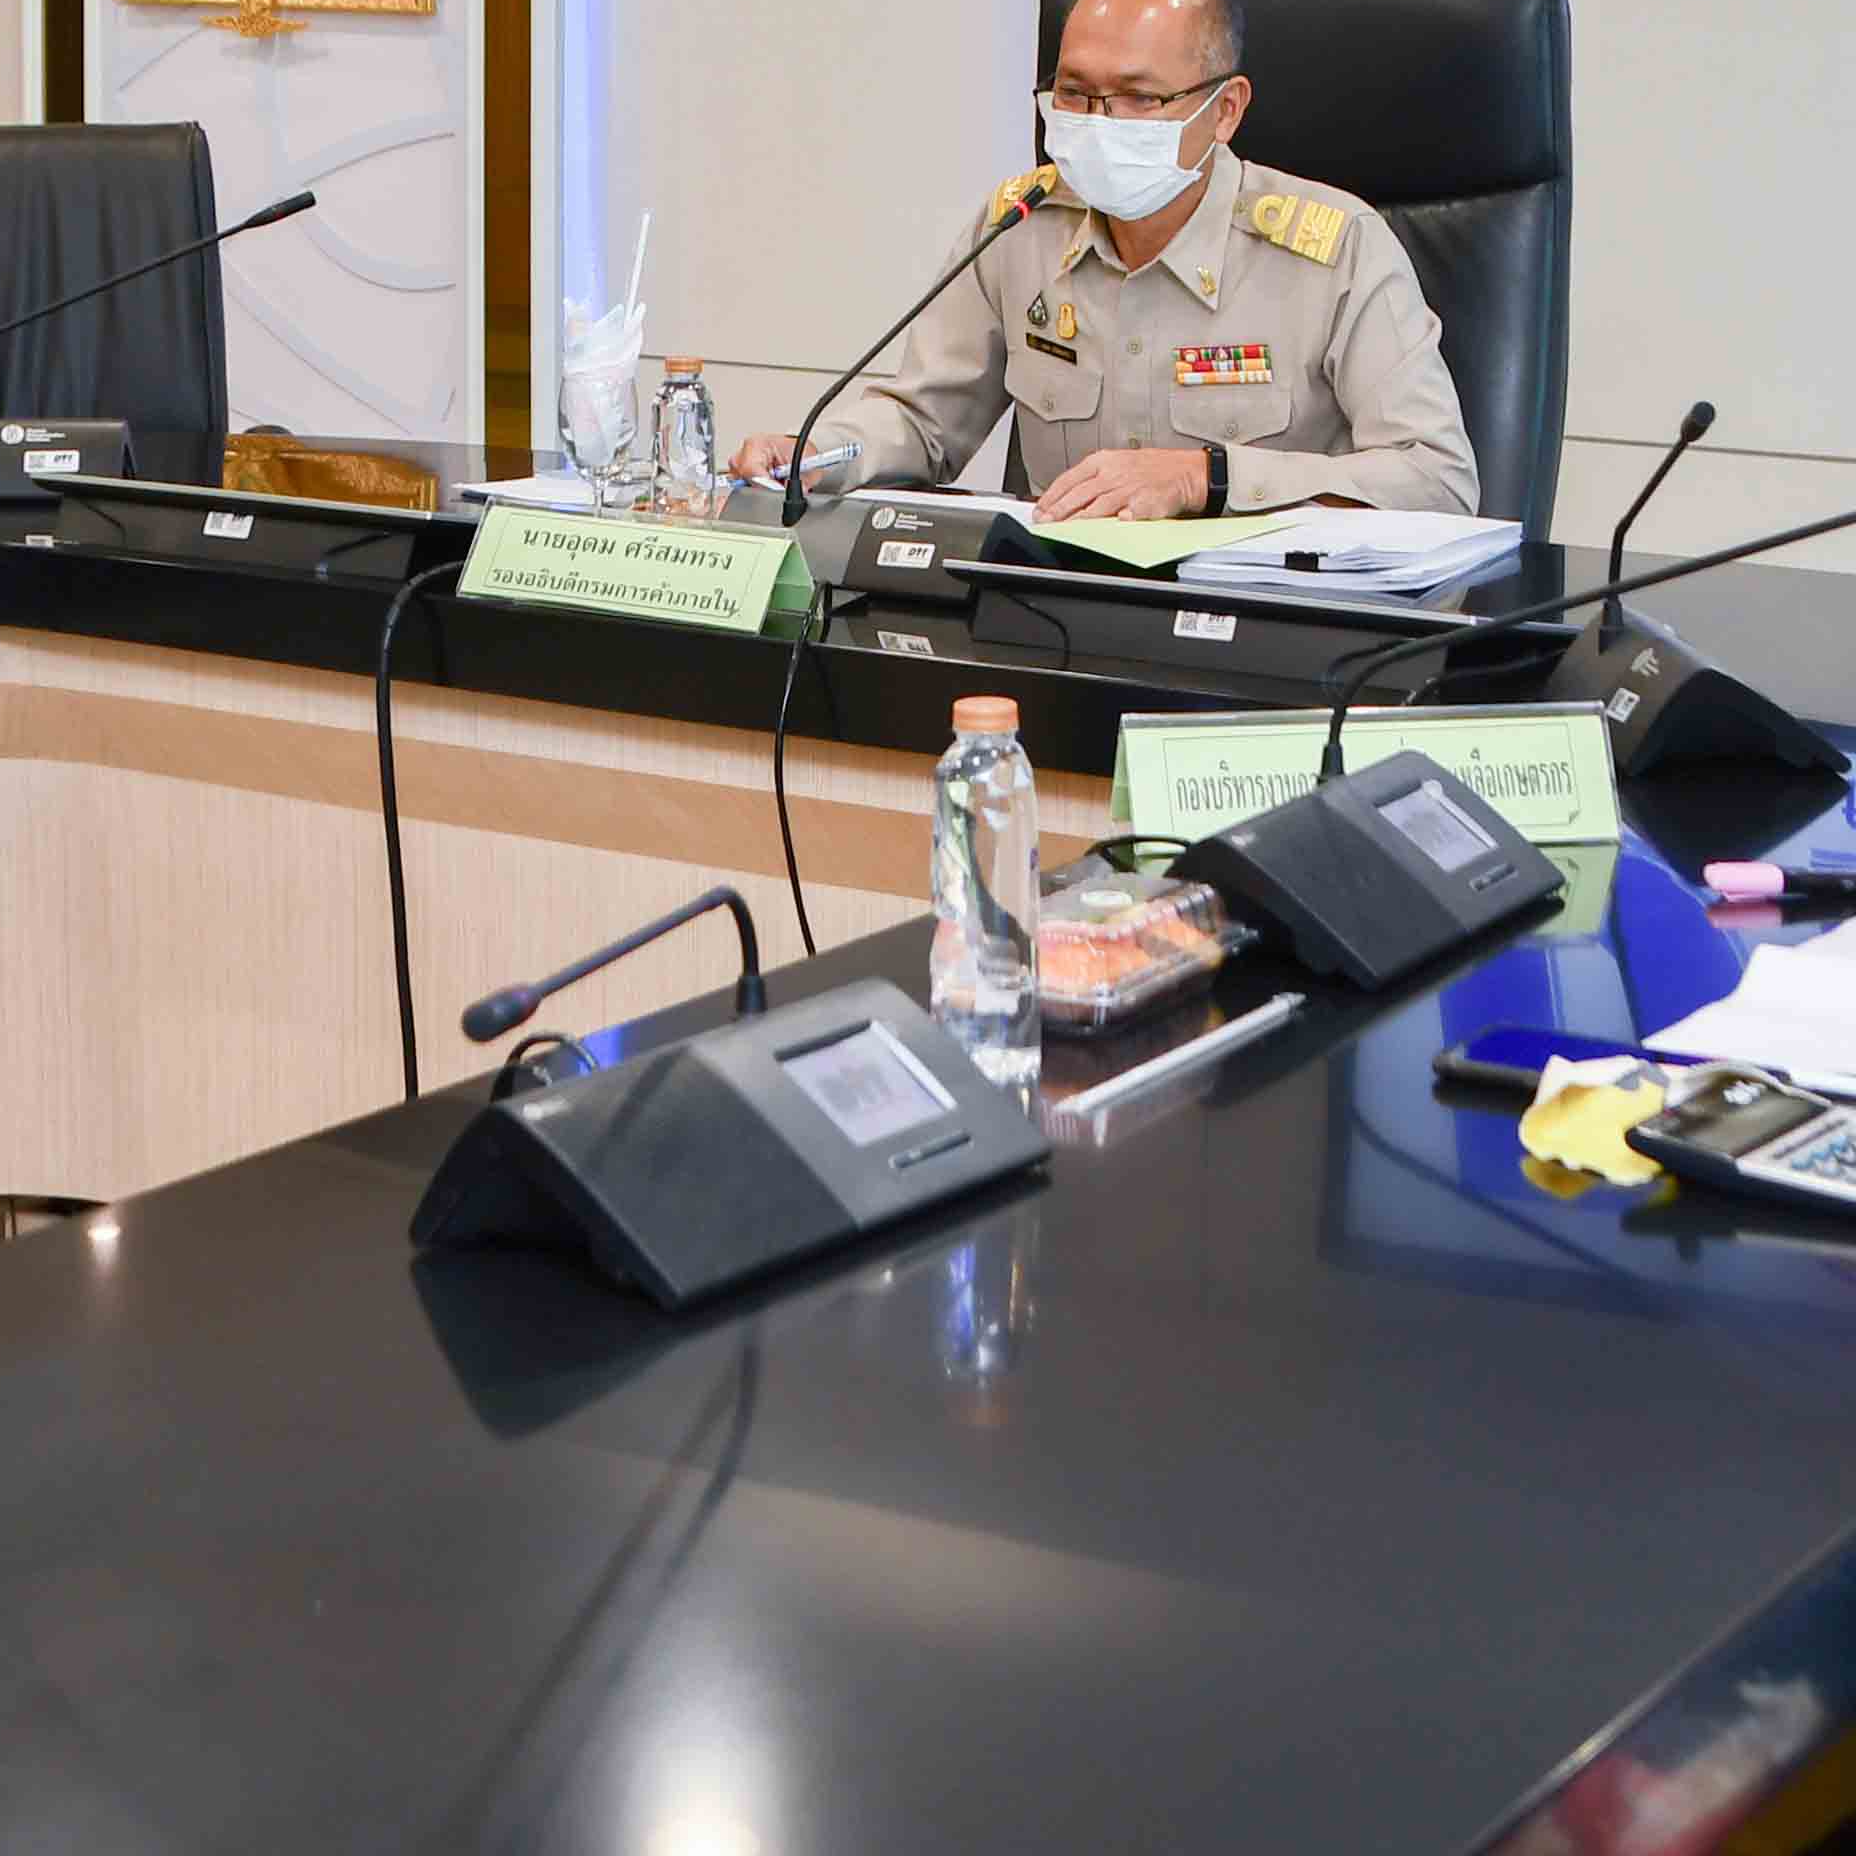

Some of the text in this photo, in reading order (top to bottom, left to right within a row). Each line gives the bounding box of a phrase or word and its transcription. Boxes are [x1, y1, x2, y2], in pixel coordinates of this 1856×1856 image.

[522, 527, 734, 571] นายอุดม ศรีสมทรง
